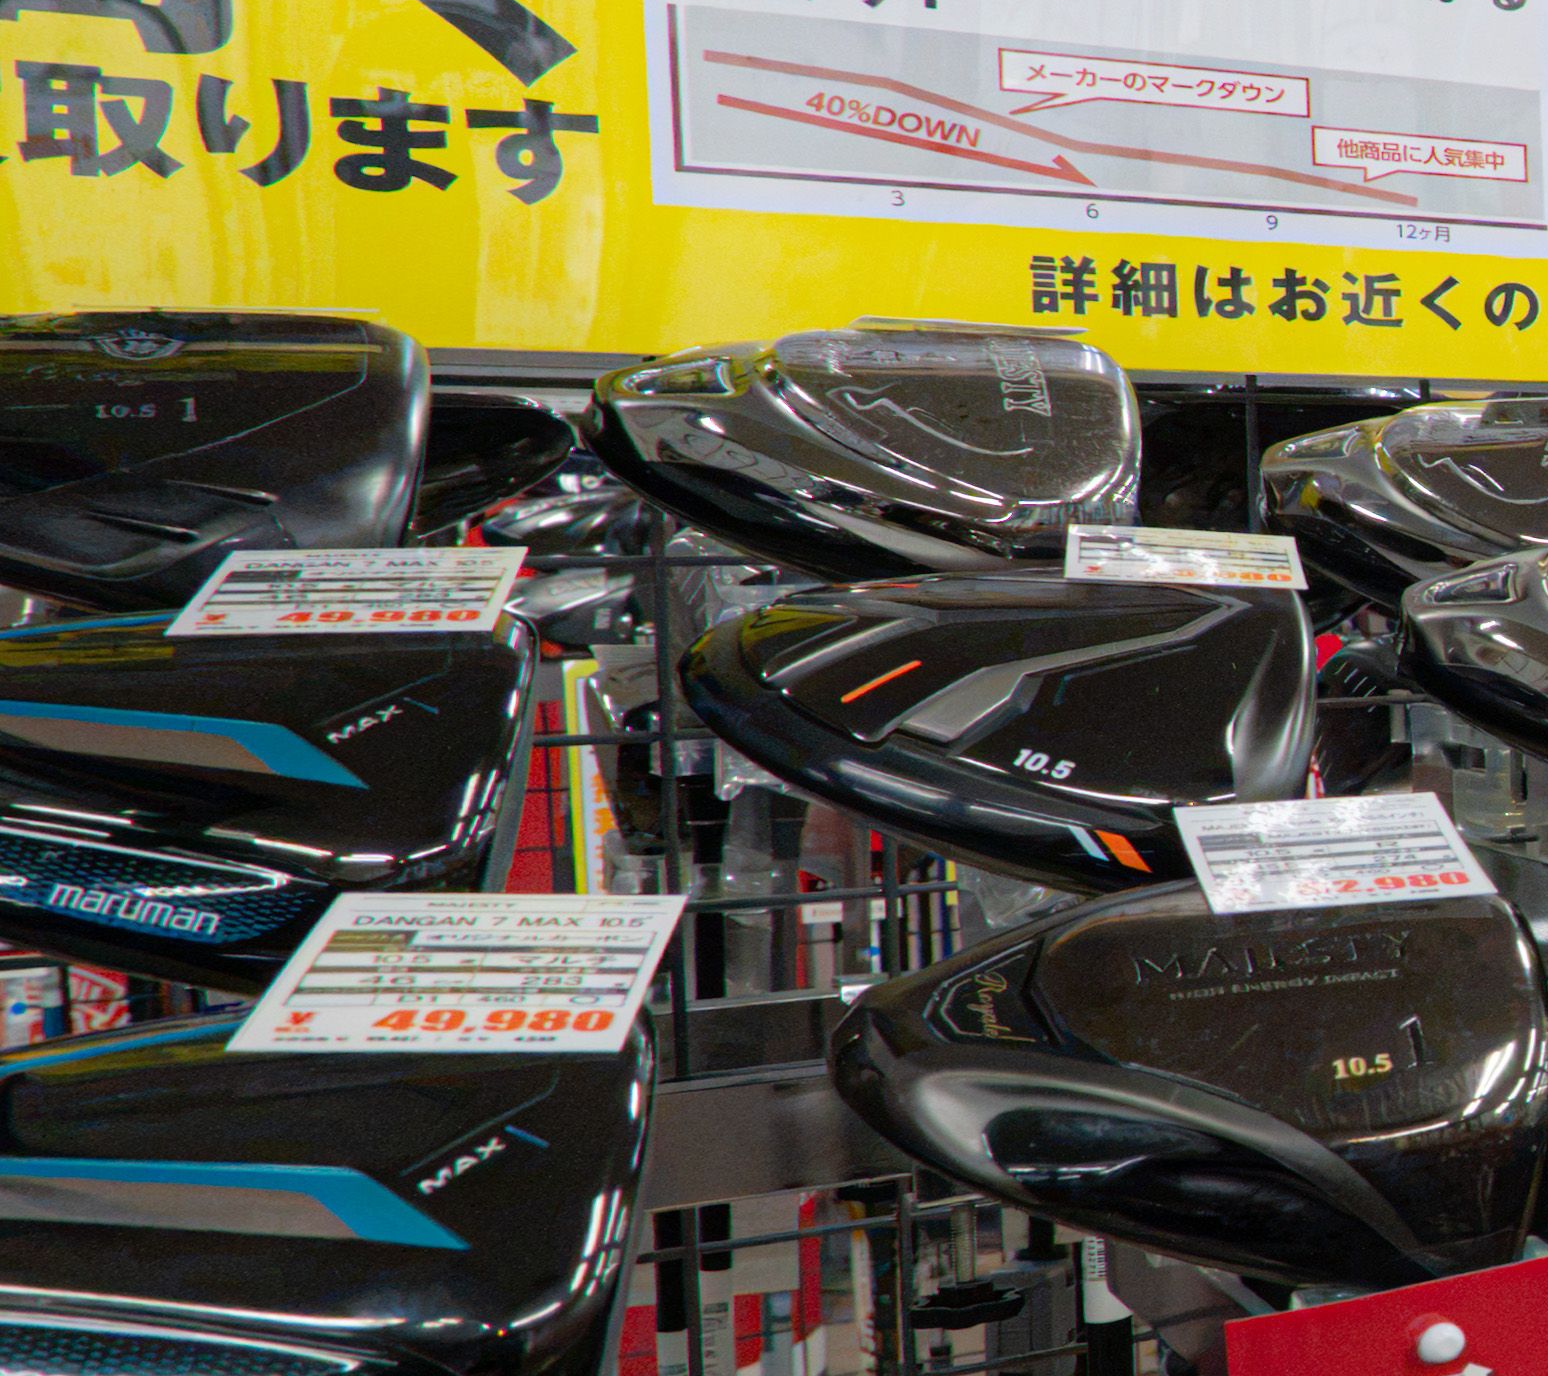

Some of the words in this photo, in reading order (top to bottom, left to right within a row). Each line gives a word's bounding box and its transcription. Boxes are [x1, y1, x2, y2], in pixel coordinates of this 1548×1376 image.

[1025, 62, 1286, 105] メーカーのマークダウン
[0, 58, 599, 205] 取ります
[805, 90, 981, 148] 40%DOWN
[1336, 137, 1505, 171] 他商品に人気集中
[891, 190, 905, 208] 3
[1086, 203, 1099, 220] 6
[1266, 215, 1279, 231] 9
[325, 705, 404, 745] MAX
[1013, 747, 1076, 781] 10.5
[48, 882, 222, 935] maruman
[517, 916, 585, 928] MAX
[371, 1010, 615, 1032] 49,980
[1331, 1053, 1393, 1080] 10.5
[417, 1136, 506, 1196] MAX
